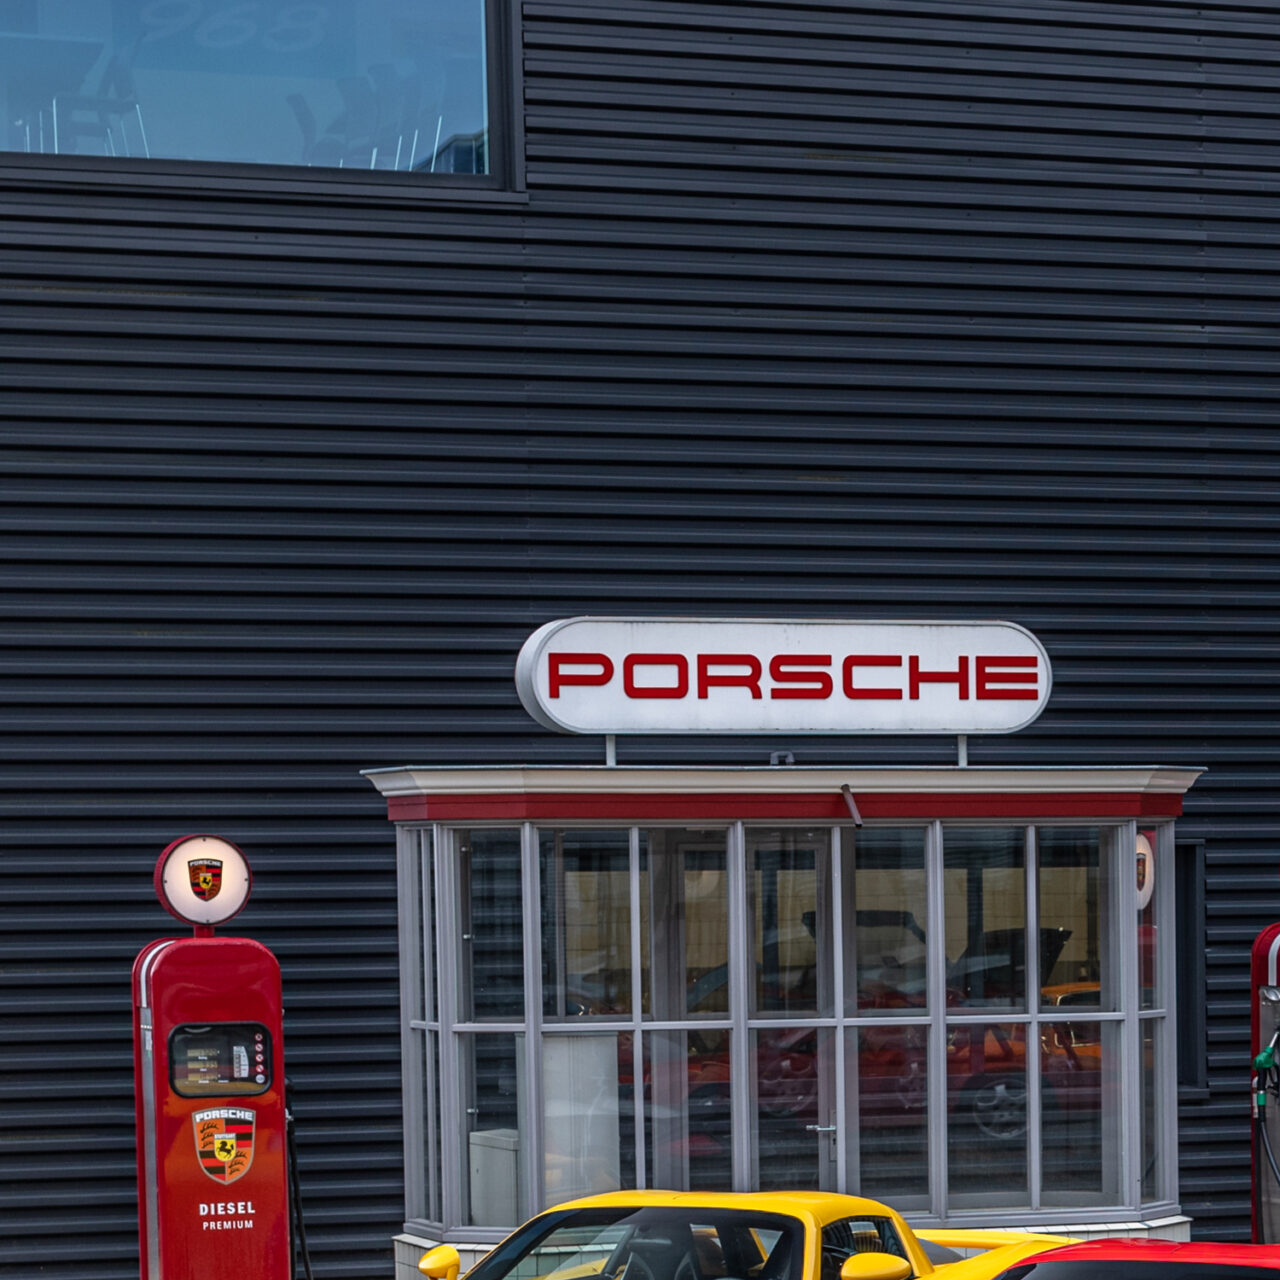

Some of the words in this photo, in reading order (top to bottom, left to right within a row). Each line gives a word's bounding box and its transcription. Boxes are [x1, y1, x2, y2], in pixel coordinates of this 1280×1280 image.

[548, 652, 1038, 700] PORSCHE
[195, 1109, 253, 1123] PORSCHE
[199, 1201, 256, 1216] DIESEL
[202, 1219, 254, 1231] PREMIUM
